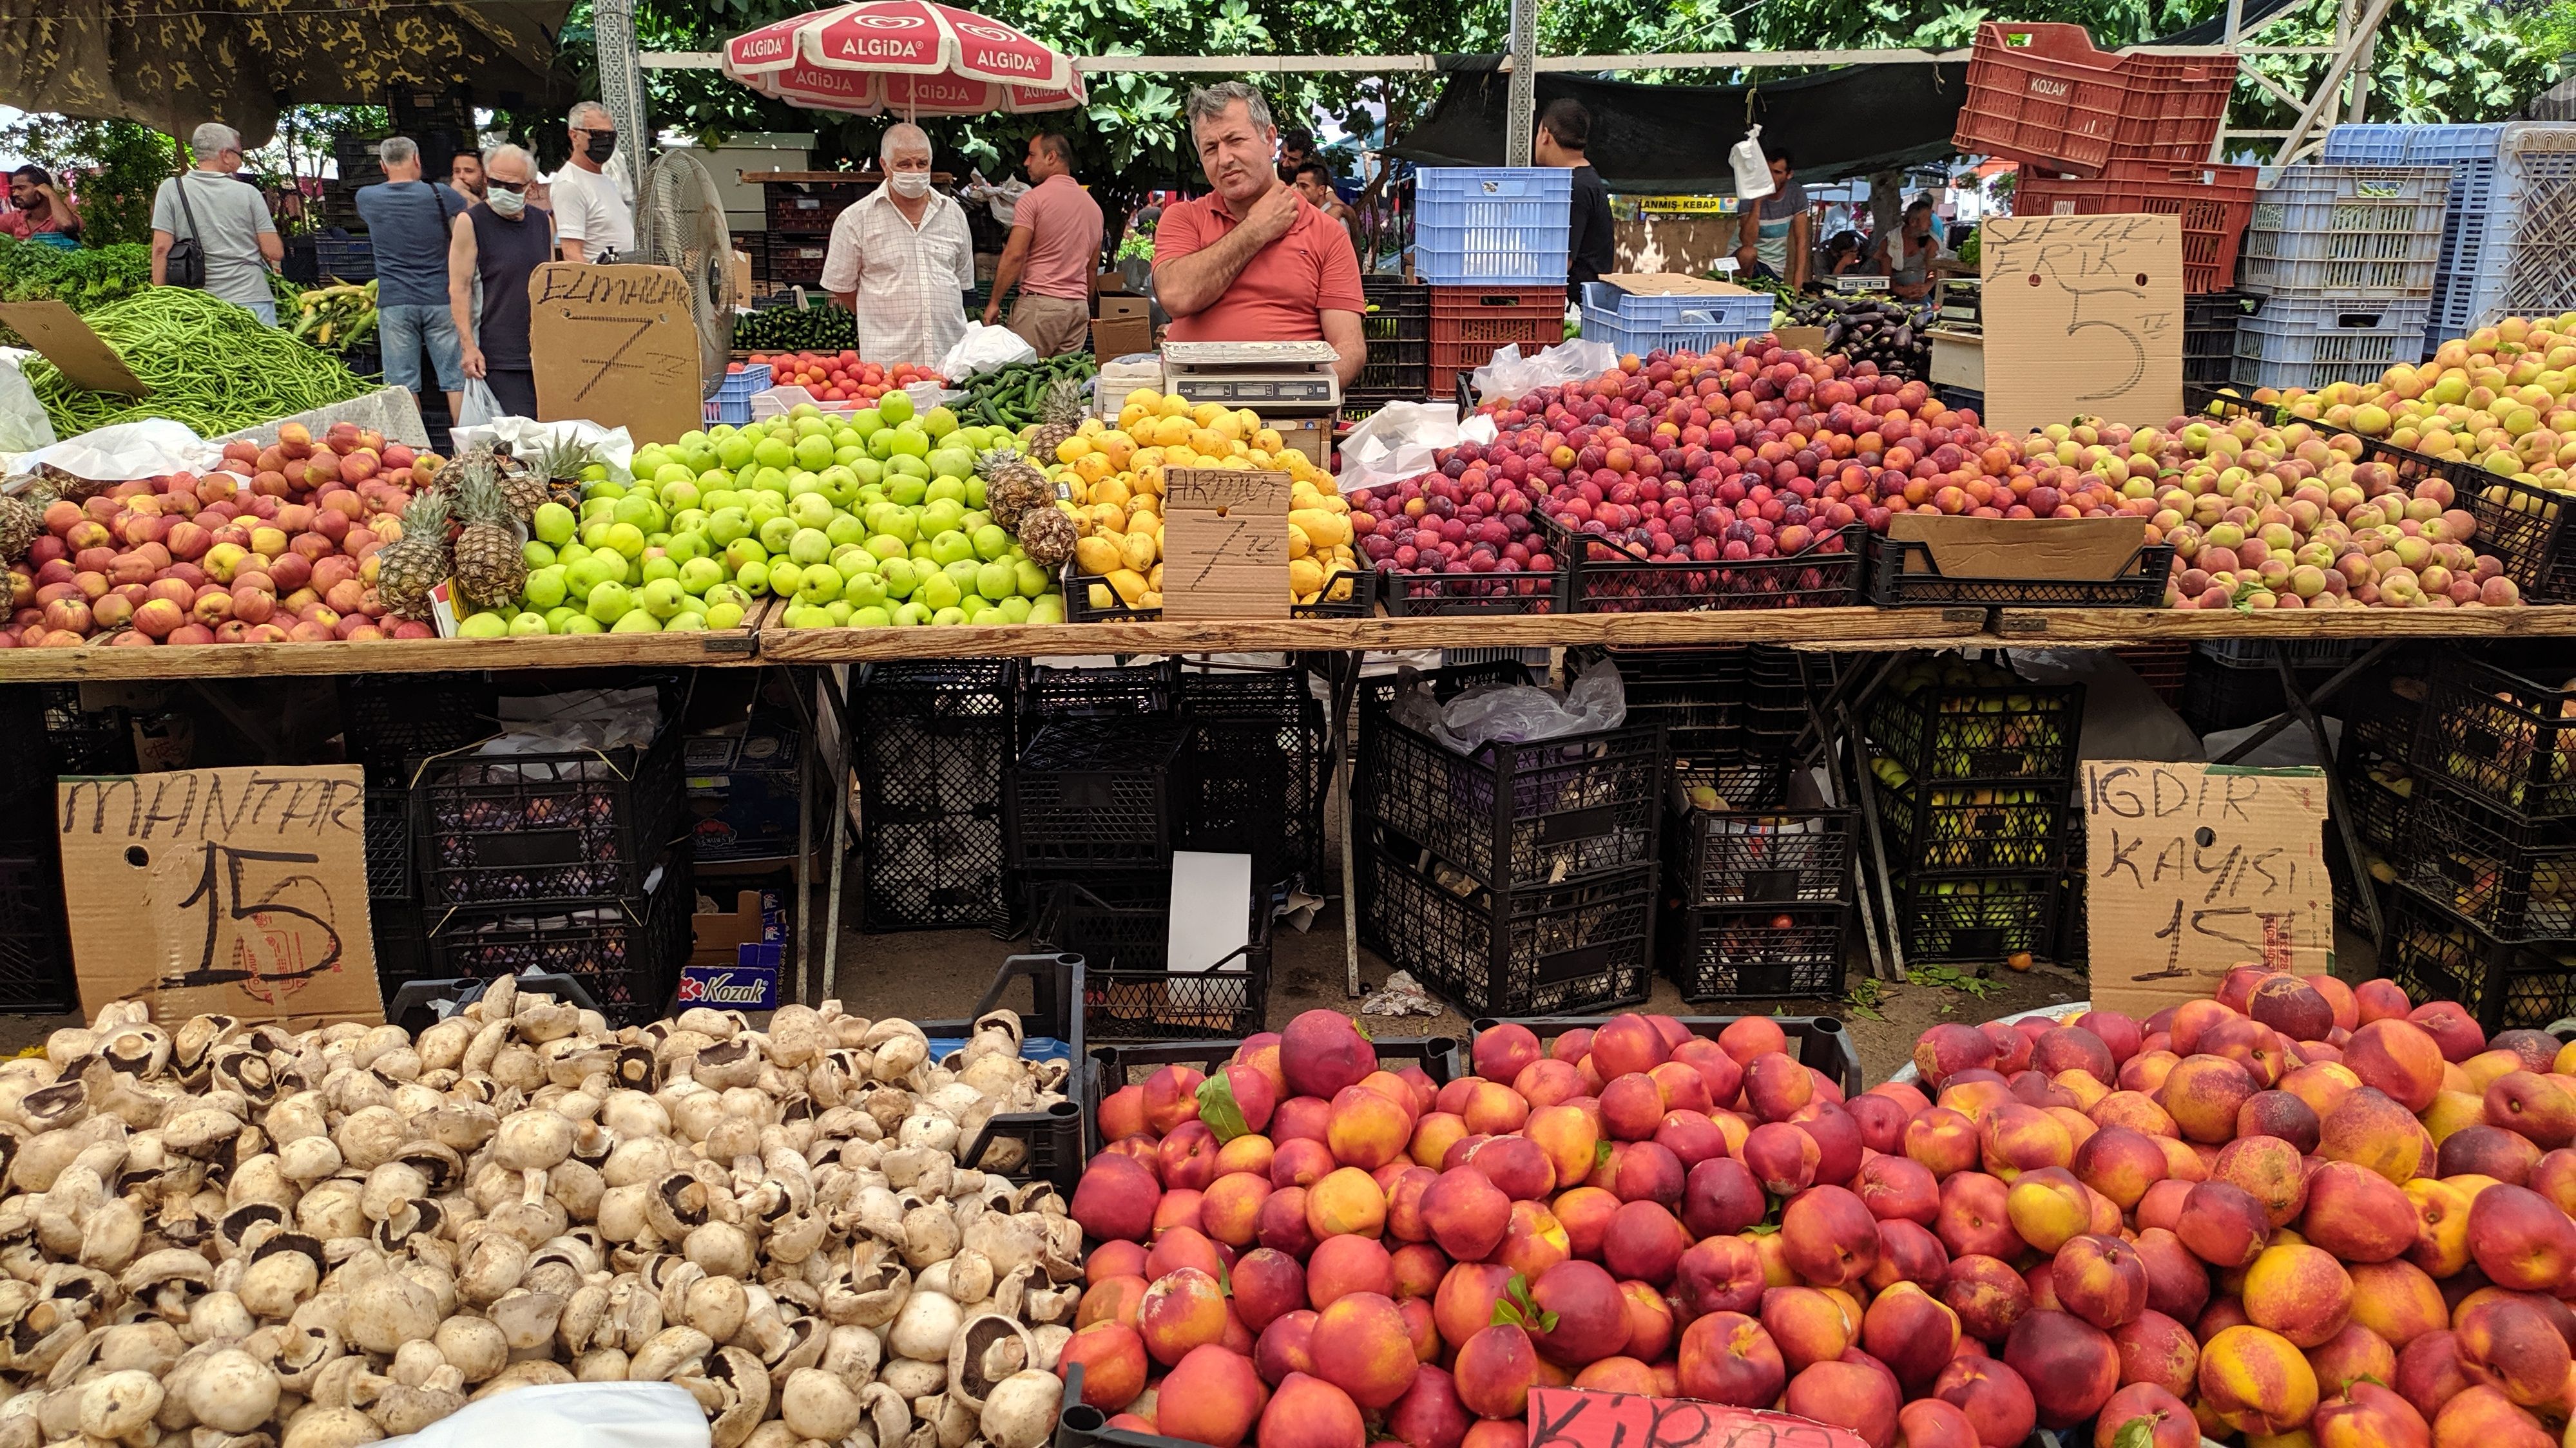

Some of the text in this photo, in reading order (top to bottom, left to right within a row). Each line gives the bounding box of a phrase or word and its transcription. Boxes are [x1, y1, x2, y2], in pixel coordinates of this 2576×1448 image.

[2031, 77, 2069, 96] KOZAK
[1683, 200, 1716, 209] KEBAP
[568, 315, 654, 402] 7
[2066, 288, 2147, 401] 5
[1191, 519, 1247, 591] 7
[63, 770, 363, 840] MANTAR
[2100, 828, 2296, 904] KAYISI
[159, 841, 342, 989] 15
[701, 973, 766, 1003] Kozak
